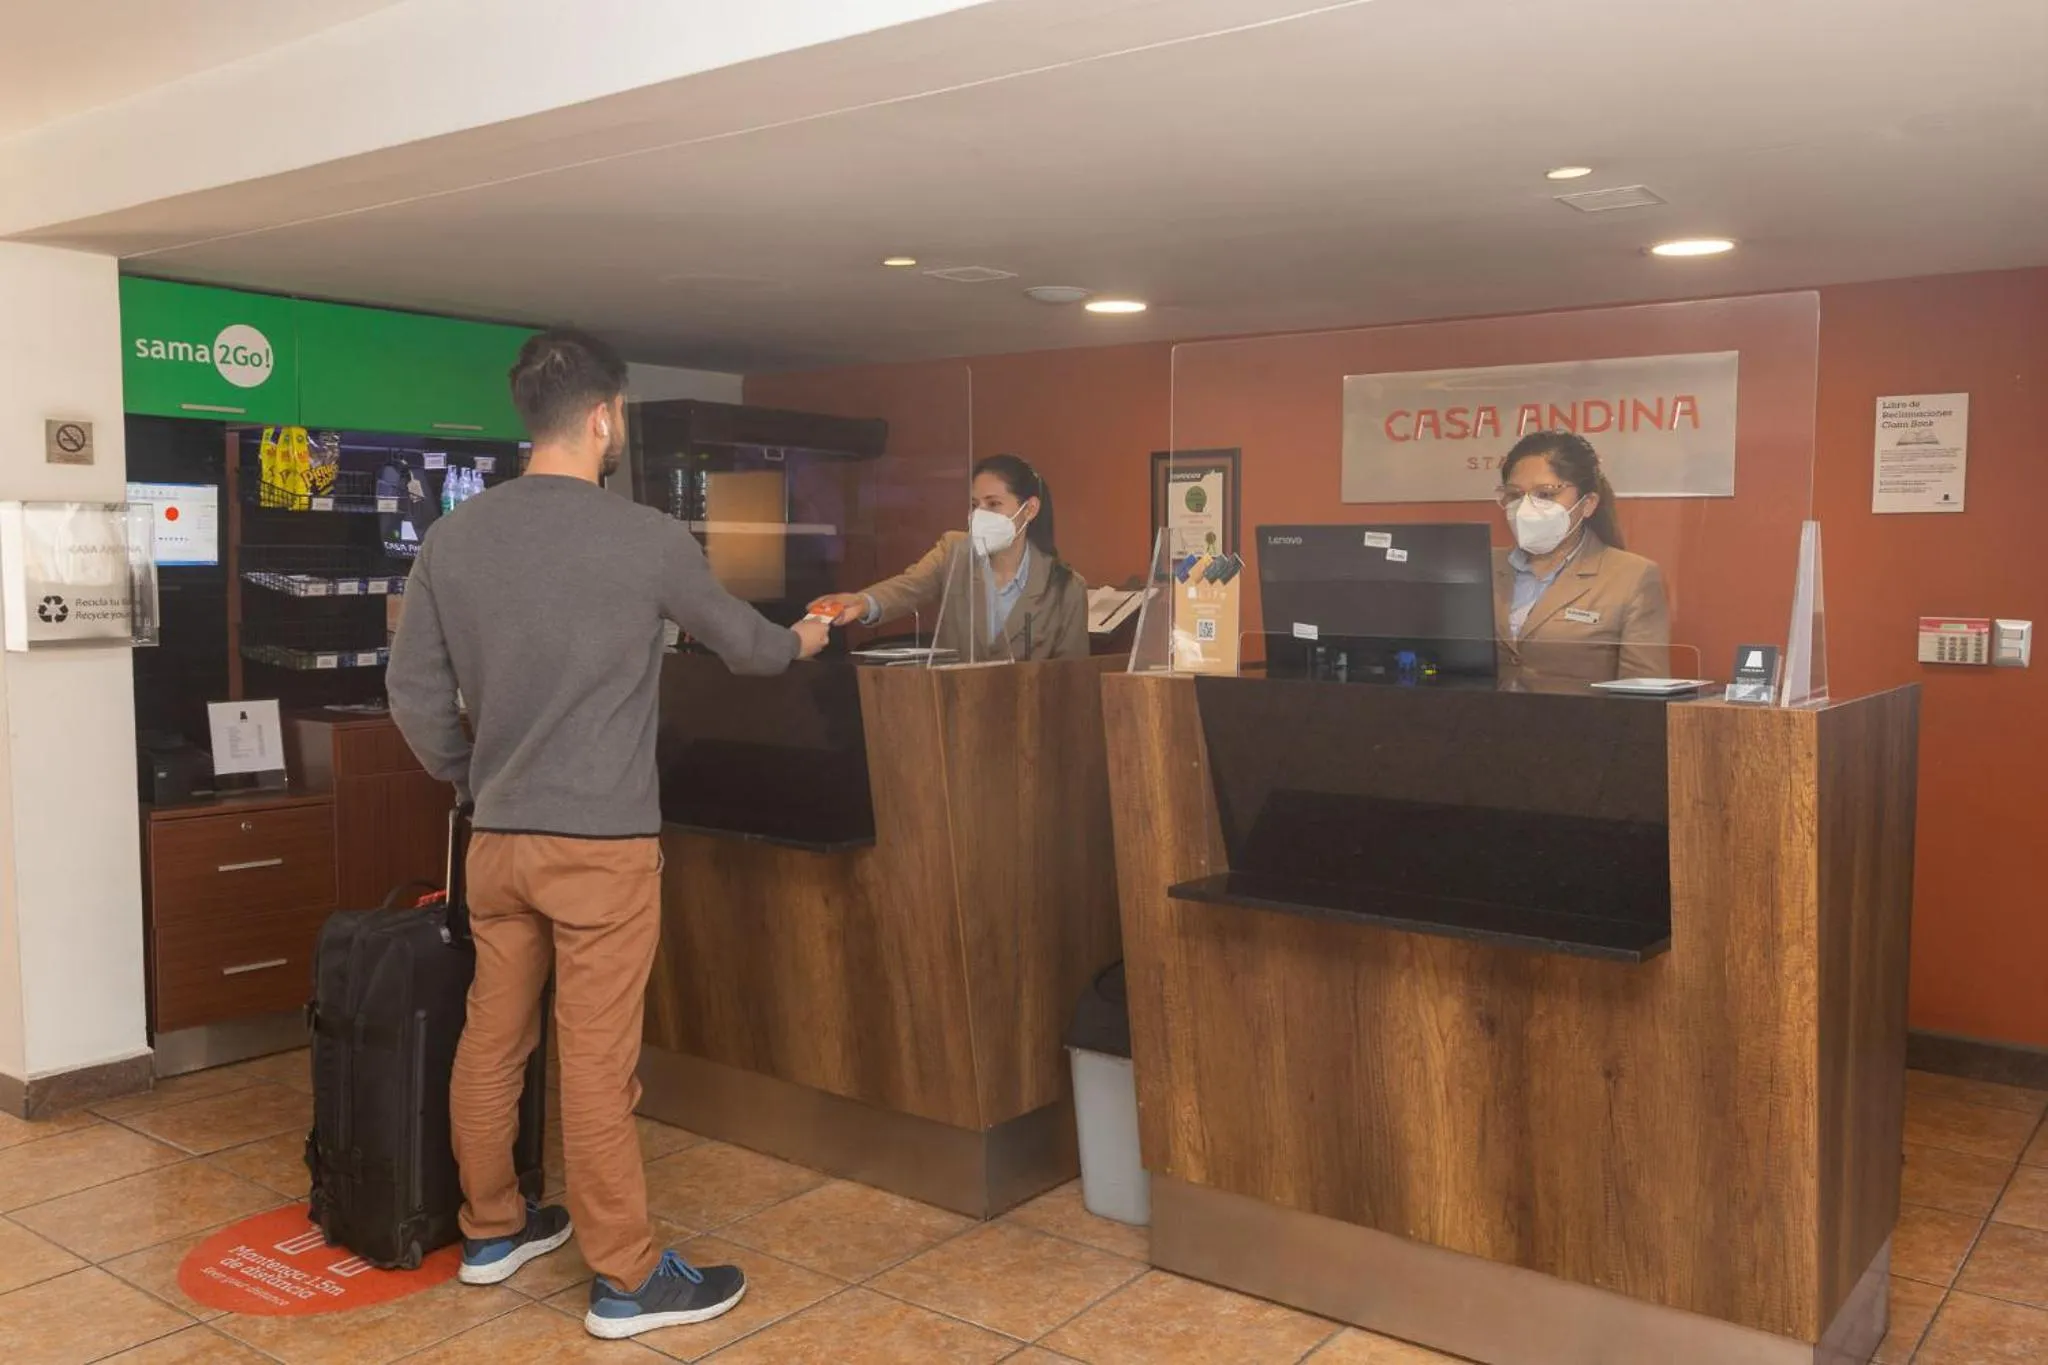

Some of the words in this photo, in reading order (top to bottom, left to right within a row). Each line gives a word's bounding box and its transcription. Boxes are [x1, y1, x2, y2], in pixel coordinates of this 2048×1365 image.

[135, 338, 210, 363] sama
[218, 344, 270, 368] 2Go!
[1384, 405, 1500, 443] CASA
[1516, 395, 1702, 437] ANDINA
[1911, 420, 1934, 428] Book
[1268, 536, 1303, 545] Lenovo
[76, 598, 109, 606] Recicla
[76, 611, 109, 621] Recycle
[228, 1245, 309, 1280] Mantenga
[220, 1257, 243, 1269] de
[240, 1266, 316, 1300] distancia
